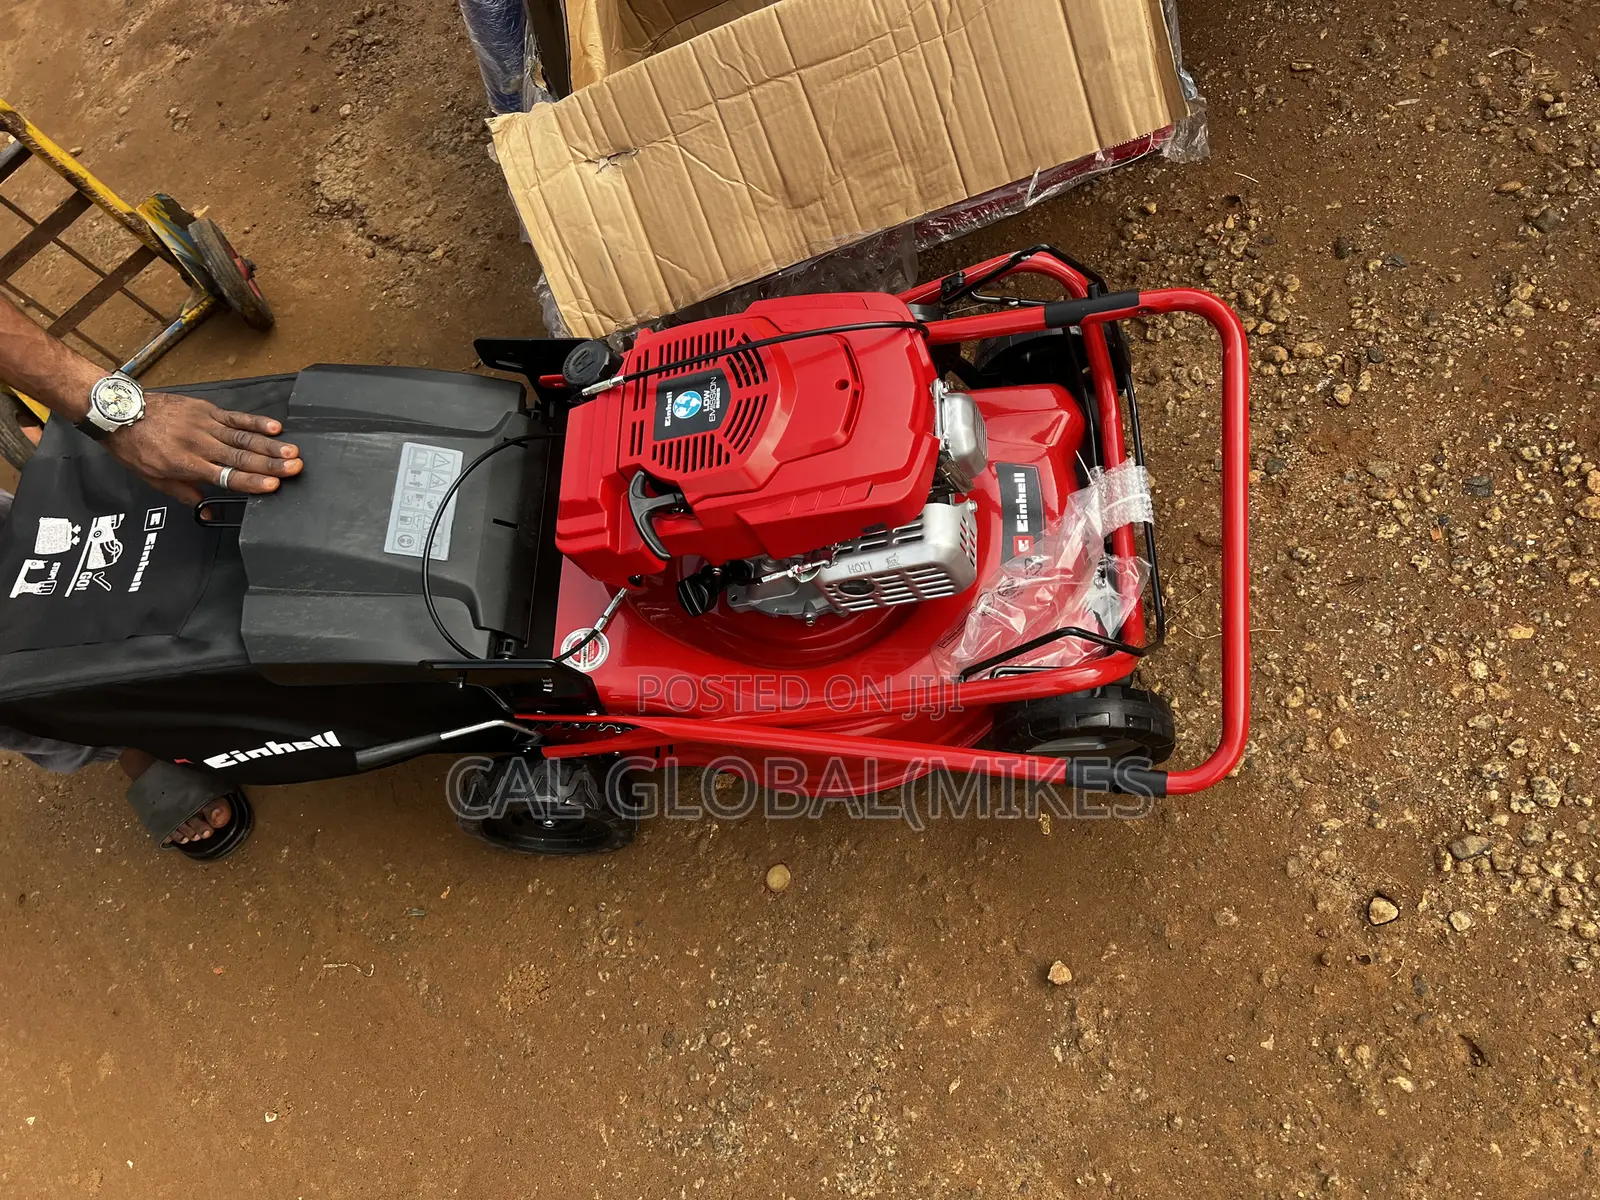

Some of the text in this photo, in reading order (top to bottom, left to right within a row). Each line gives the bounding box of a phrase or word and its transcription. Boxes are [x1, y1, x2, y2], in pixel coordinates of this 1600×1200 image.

[1013, 472, 1029, 532] Einhell
[47, 561, 61, 580] STOP!
[74, 571, 93, 591] GO!
[128, 532, 158, 593] Einhell
[203, 730, 342, 769] Einhell
